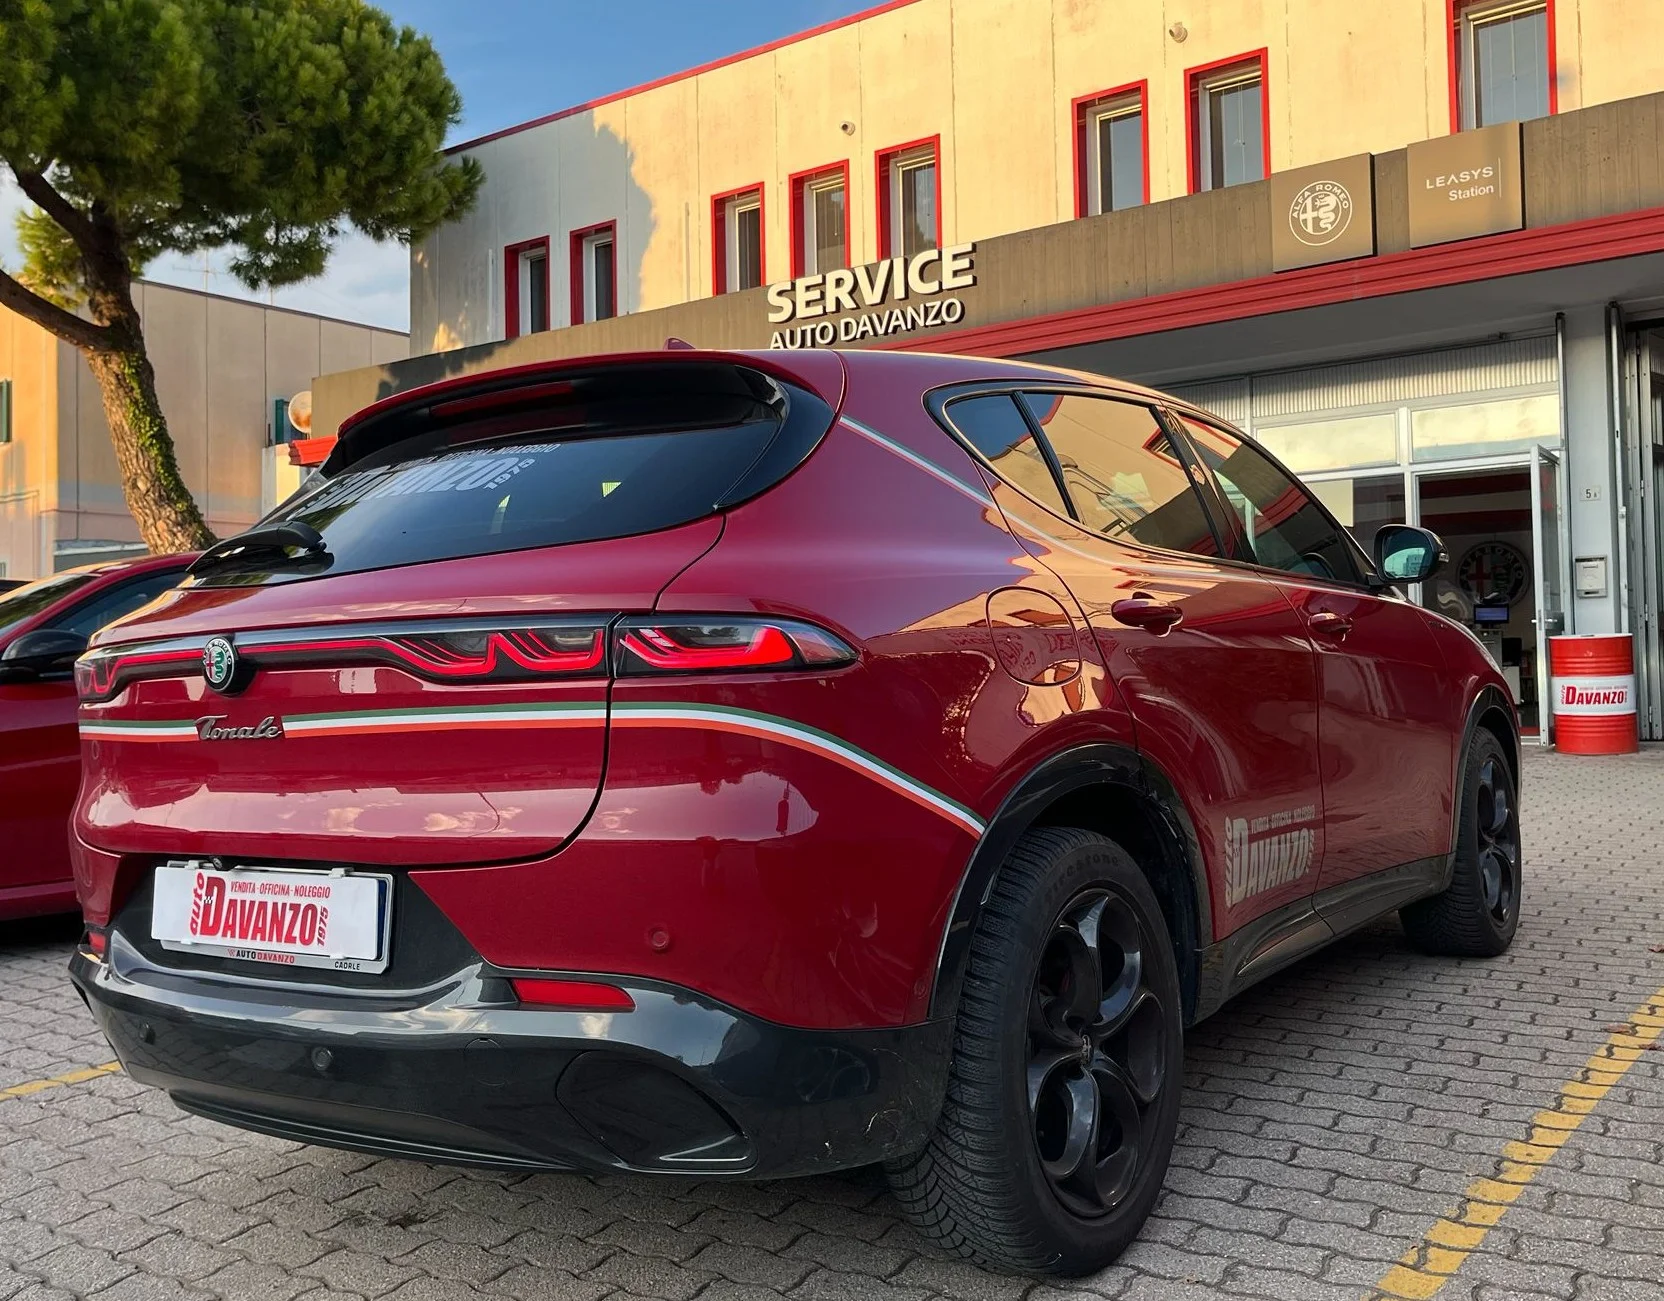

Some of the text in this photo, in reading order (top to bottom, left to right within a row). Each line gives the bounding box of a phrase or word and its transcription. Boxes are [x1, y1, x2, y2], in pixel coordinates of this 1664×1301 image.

[1292, 184, 1349, 218] ALFA ROMEO
[1448, 185, 1494, 201] Station
[767, 242, 974, 323] SERVICE
[770, 298, 962, 349] AUTO DAVANZO
[483, 458, 535, 489] 1975
[1565, 686, 1625, 705] DAVANZO
[194, 714, 283, 740] Tonale
[1232, 817, 1309, 905] DAVANZO
[190, 872, 204, 936] auto
[230, 881, 331, 899] VENDITA OFFICINA NOLEGGIO
[200, 876, 318, 946] DAVANZO
[317, 906, 329, 947] 1975
